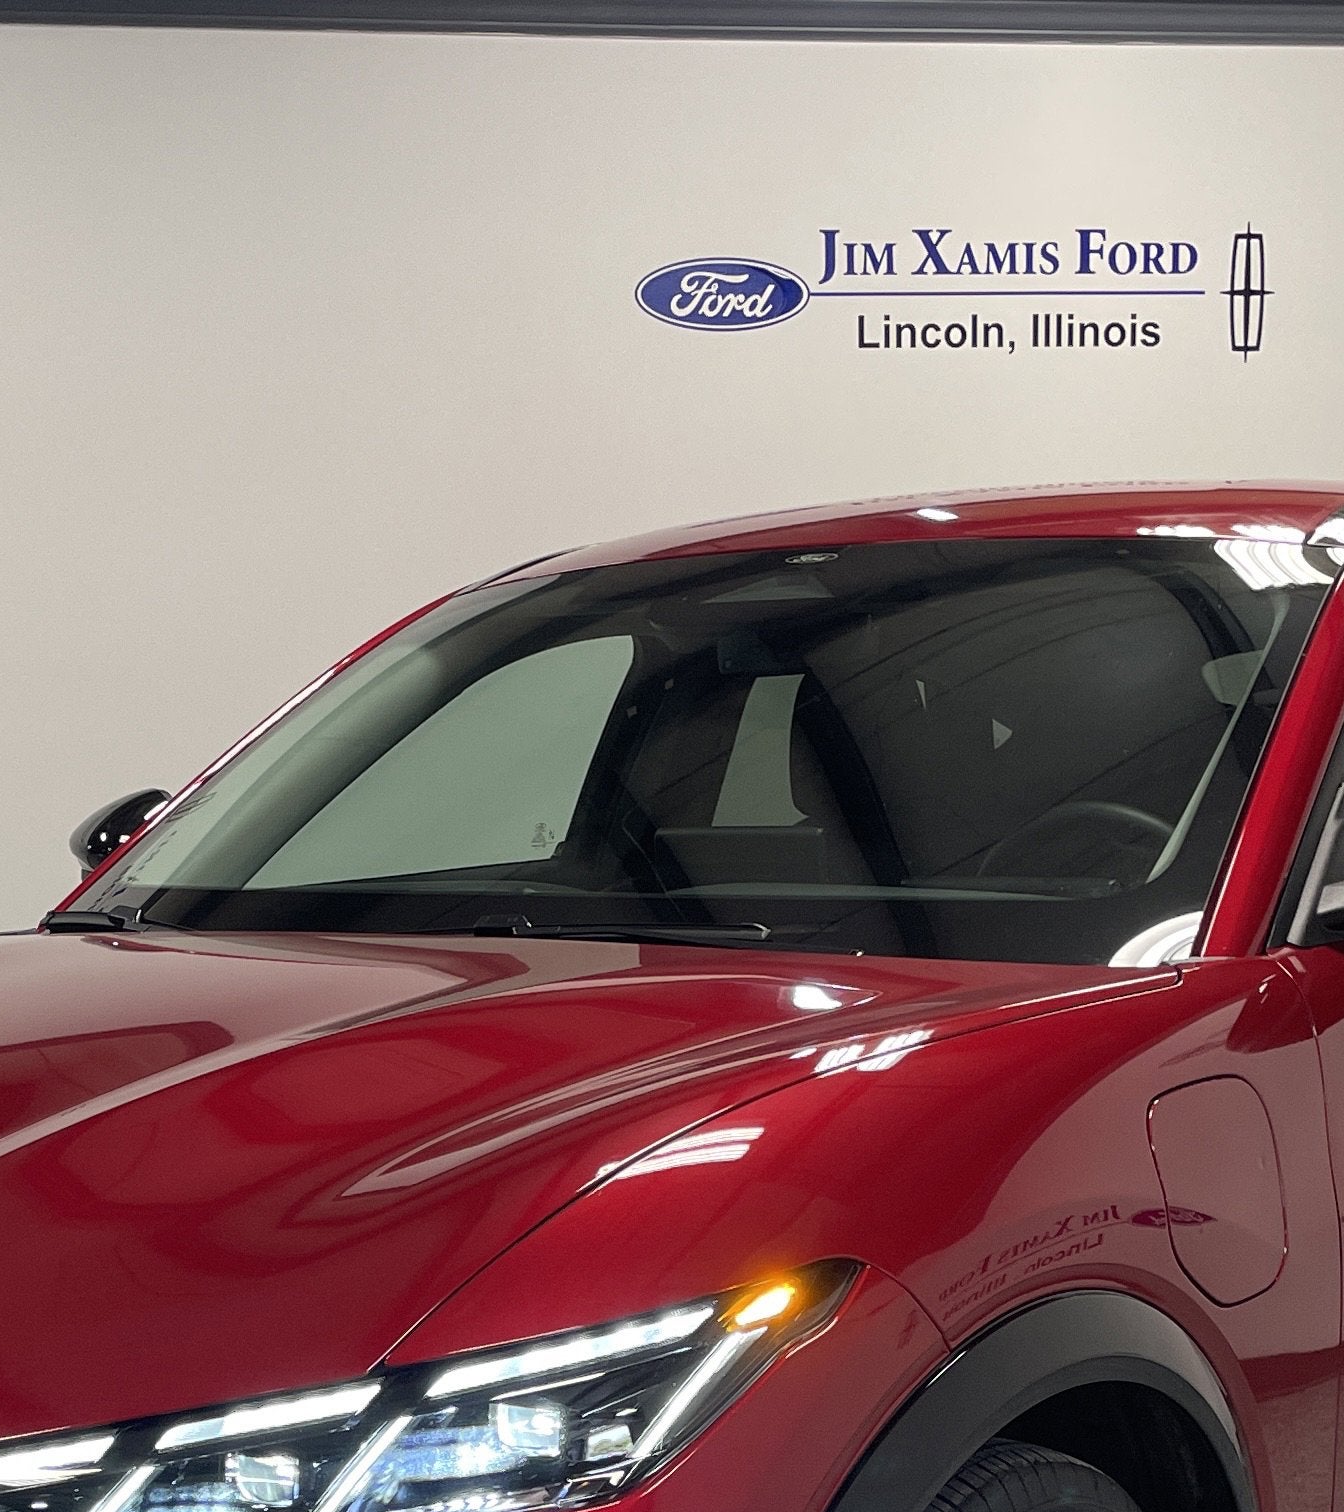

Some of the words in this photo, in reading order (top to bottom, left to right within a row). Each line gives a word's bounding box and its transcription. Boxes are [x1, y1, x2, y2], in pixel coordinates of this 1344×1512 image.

[817, 228, 898, 286] JIM
[910, 228, 1060, 276] XAMIS
[1074, 228, 1199, 276] FORD
[670, 272, 775, 318] Ford
[857, 313, 1016, 356] Lincoln,
[1031, 312, 1161, 349] Illinois
